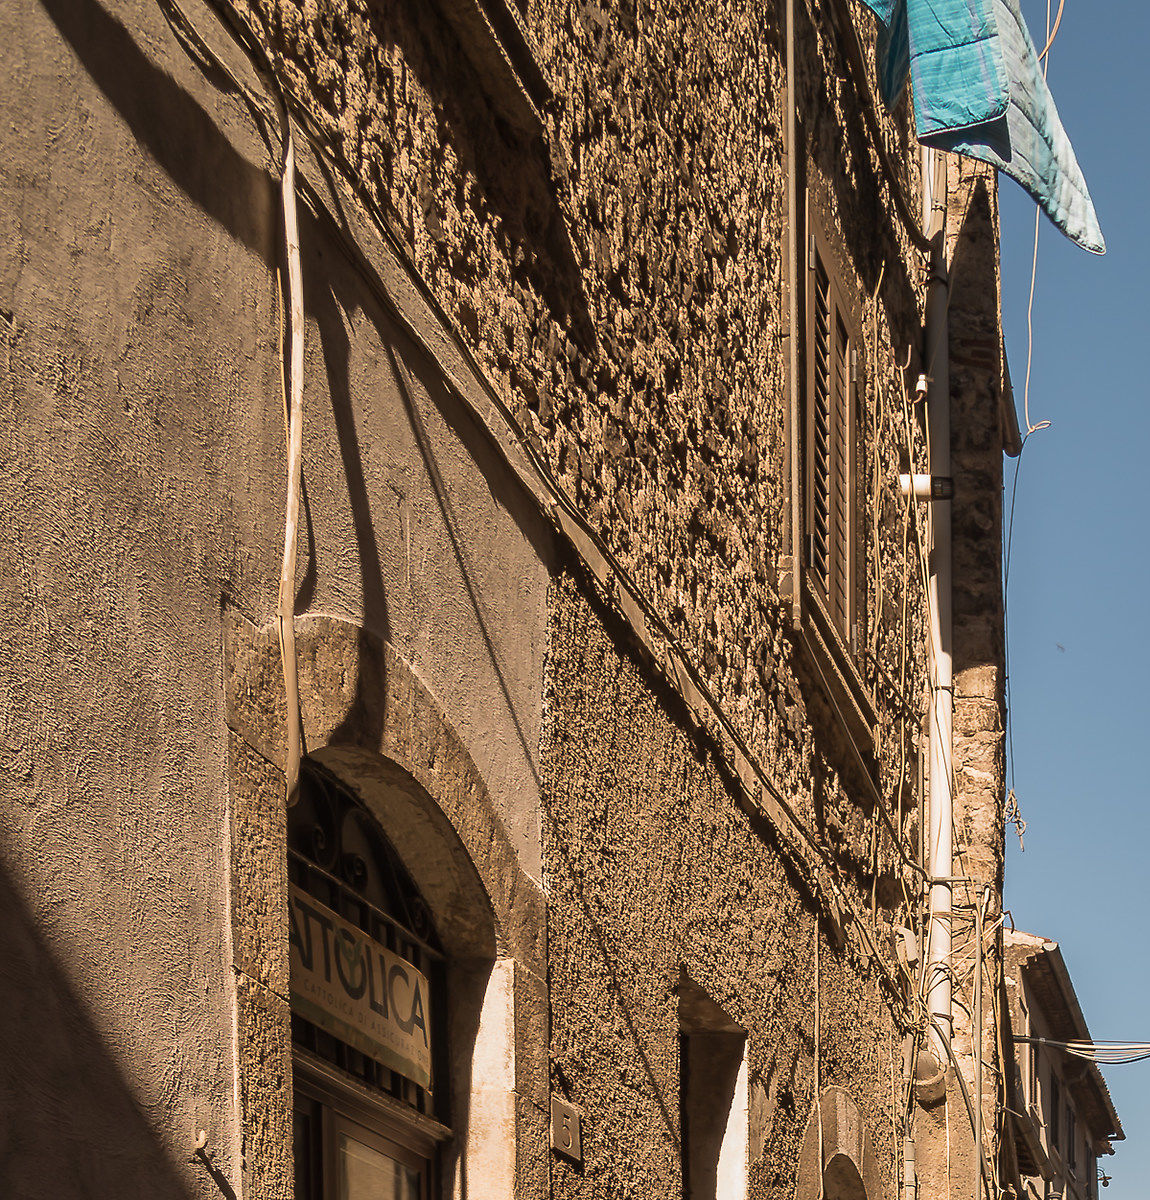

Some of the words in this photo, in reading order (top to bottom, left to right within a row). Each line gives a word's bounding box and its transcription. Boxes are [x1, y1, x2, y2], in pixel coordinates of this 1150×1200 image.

[290, 896, 429, 1049] ATTOLICA
[303, 979, 354, 1016] CATTOLICA
[359, 1011, 367, 1025] DI
[562, 1113, 573, 1149] 5
